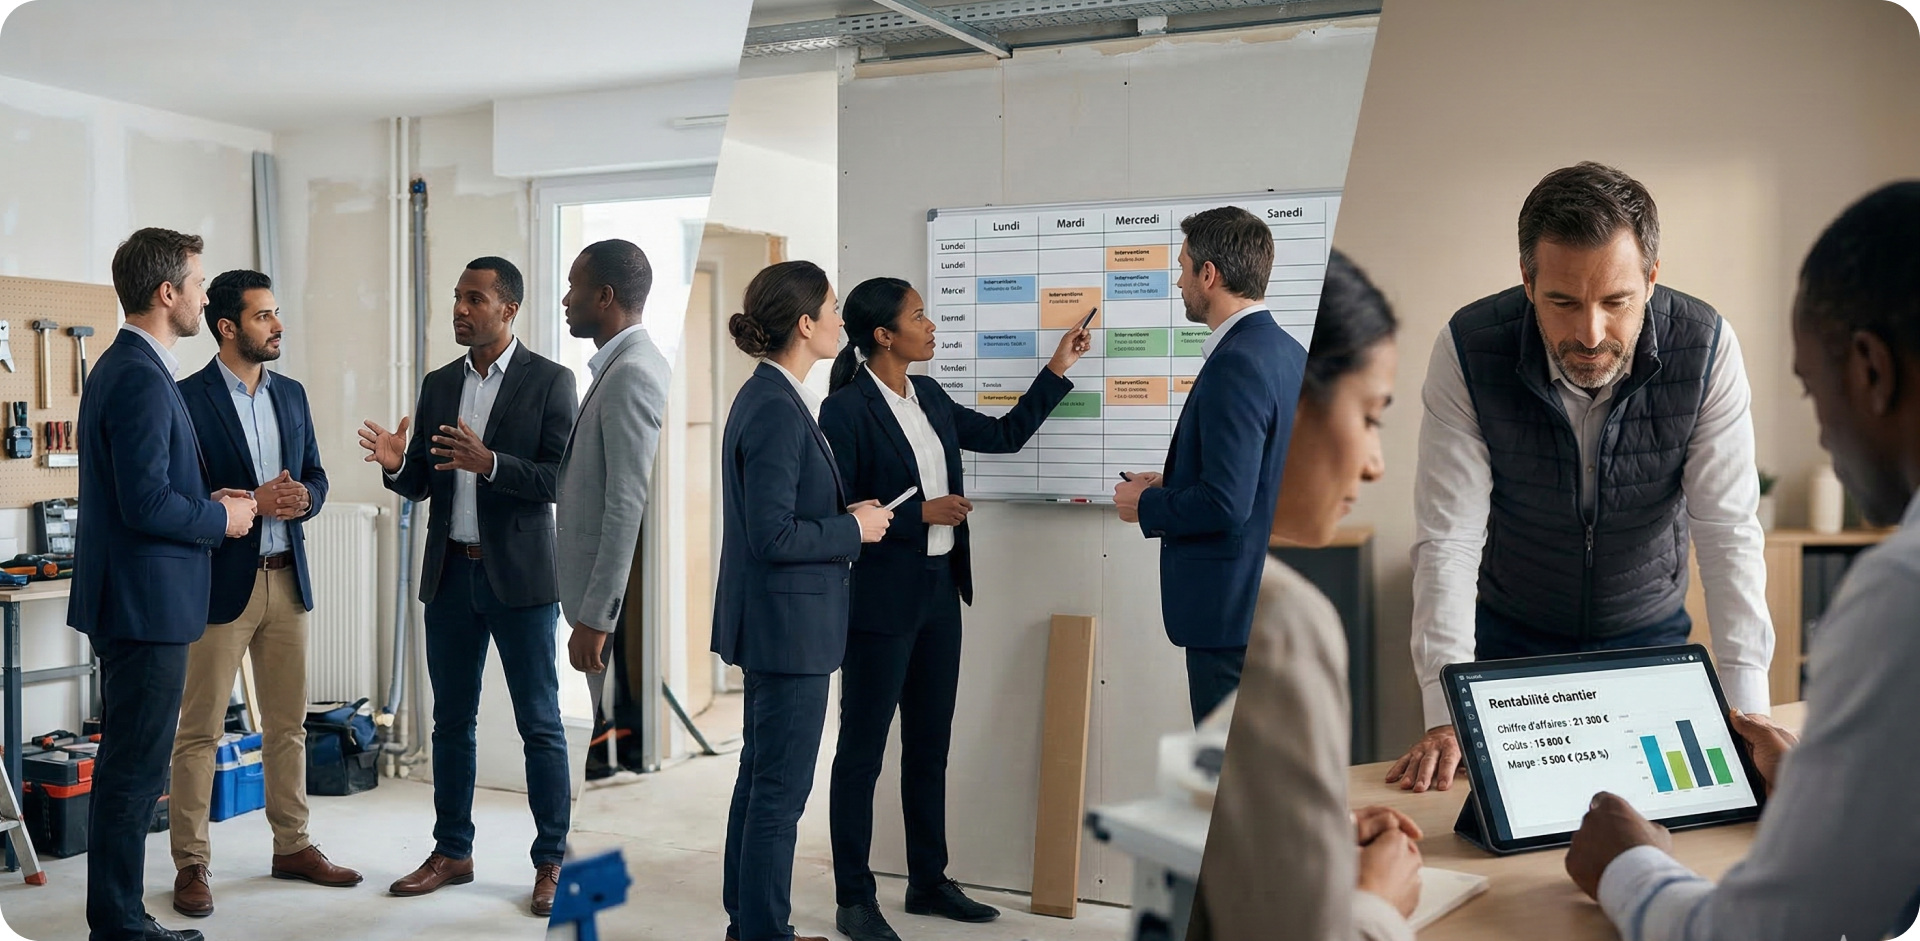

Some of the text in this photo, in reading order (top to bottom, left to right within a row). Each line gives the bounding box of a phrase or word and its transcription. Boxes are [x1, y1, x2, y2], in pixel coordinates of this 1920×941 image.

[1267, 207, 1303, 219] Sanedi
[993, 221, 1020, 231] Lundi
[1057, 218, 1085, 228] Mardi
[1115, 214, 1160, 226] Mercredi
[1489, 690, 1597, 709] Rentabilité chantier
[1497, 722, 1527, 734] Chiffre
[1528, 718, 1567, 731] d'affaires
[1573, 717, 1583, 726] 21
[1585, 715, 1601, 725] 300
[1603, 714, 1610, 723] €
[1502, 739, 1529, 751] Coûts
[1534, 738, 1546, 748] 15
[1547, 736, 1563, 747] 800
[1565, 735, 1571, 745] €
[1541, 756, 1548, 765] 5
[1549, 754, 1566, 764] 500
[1567, 753, 1574, 762] €
